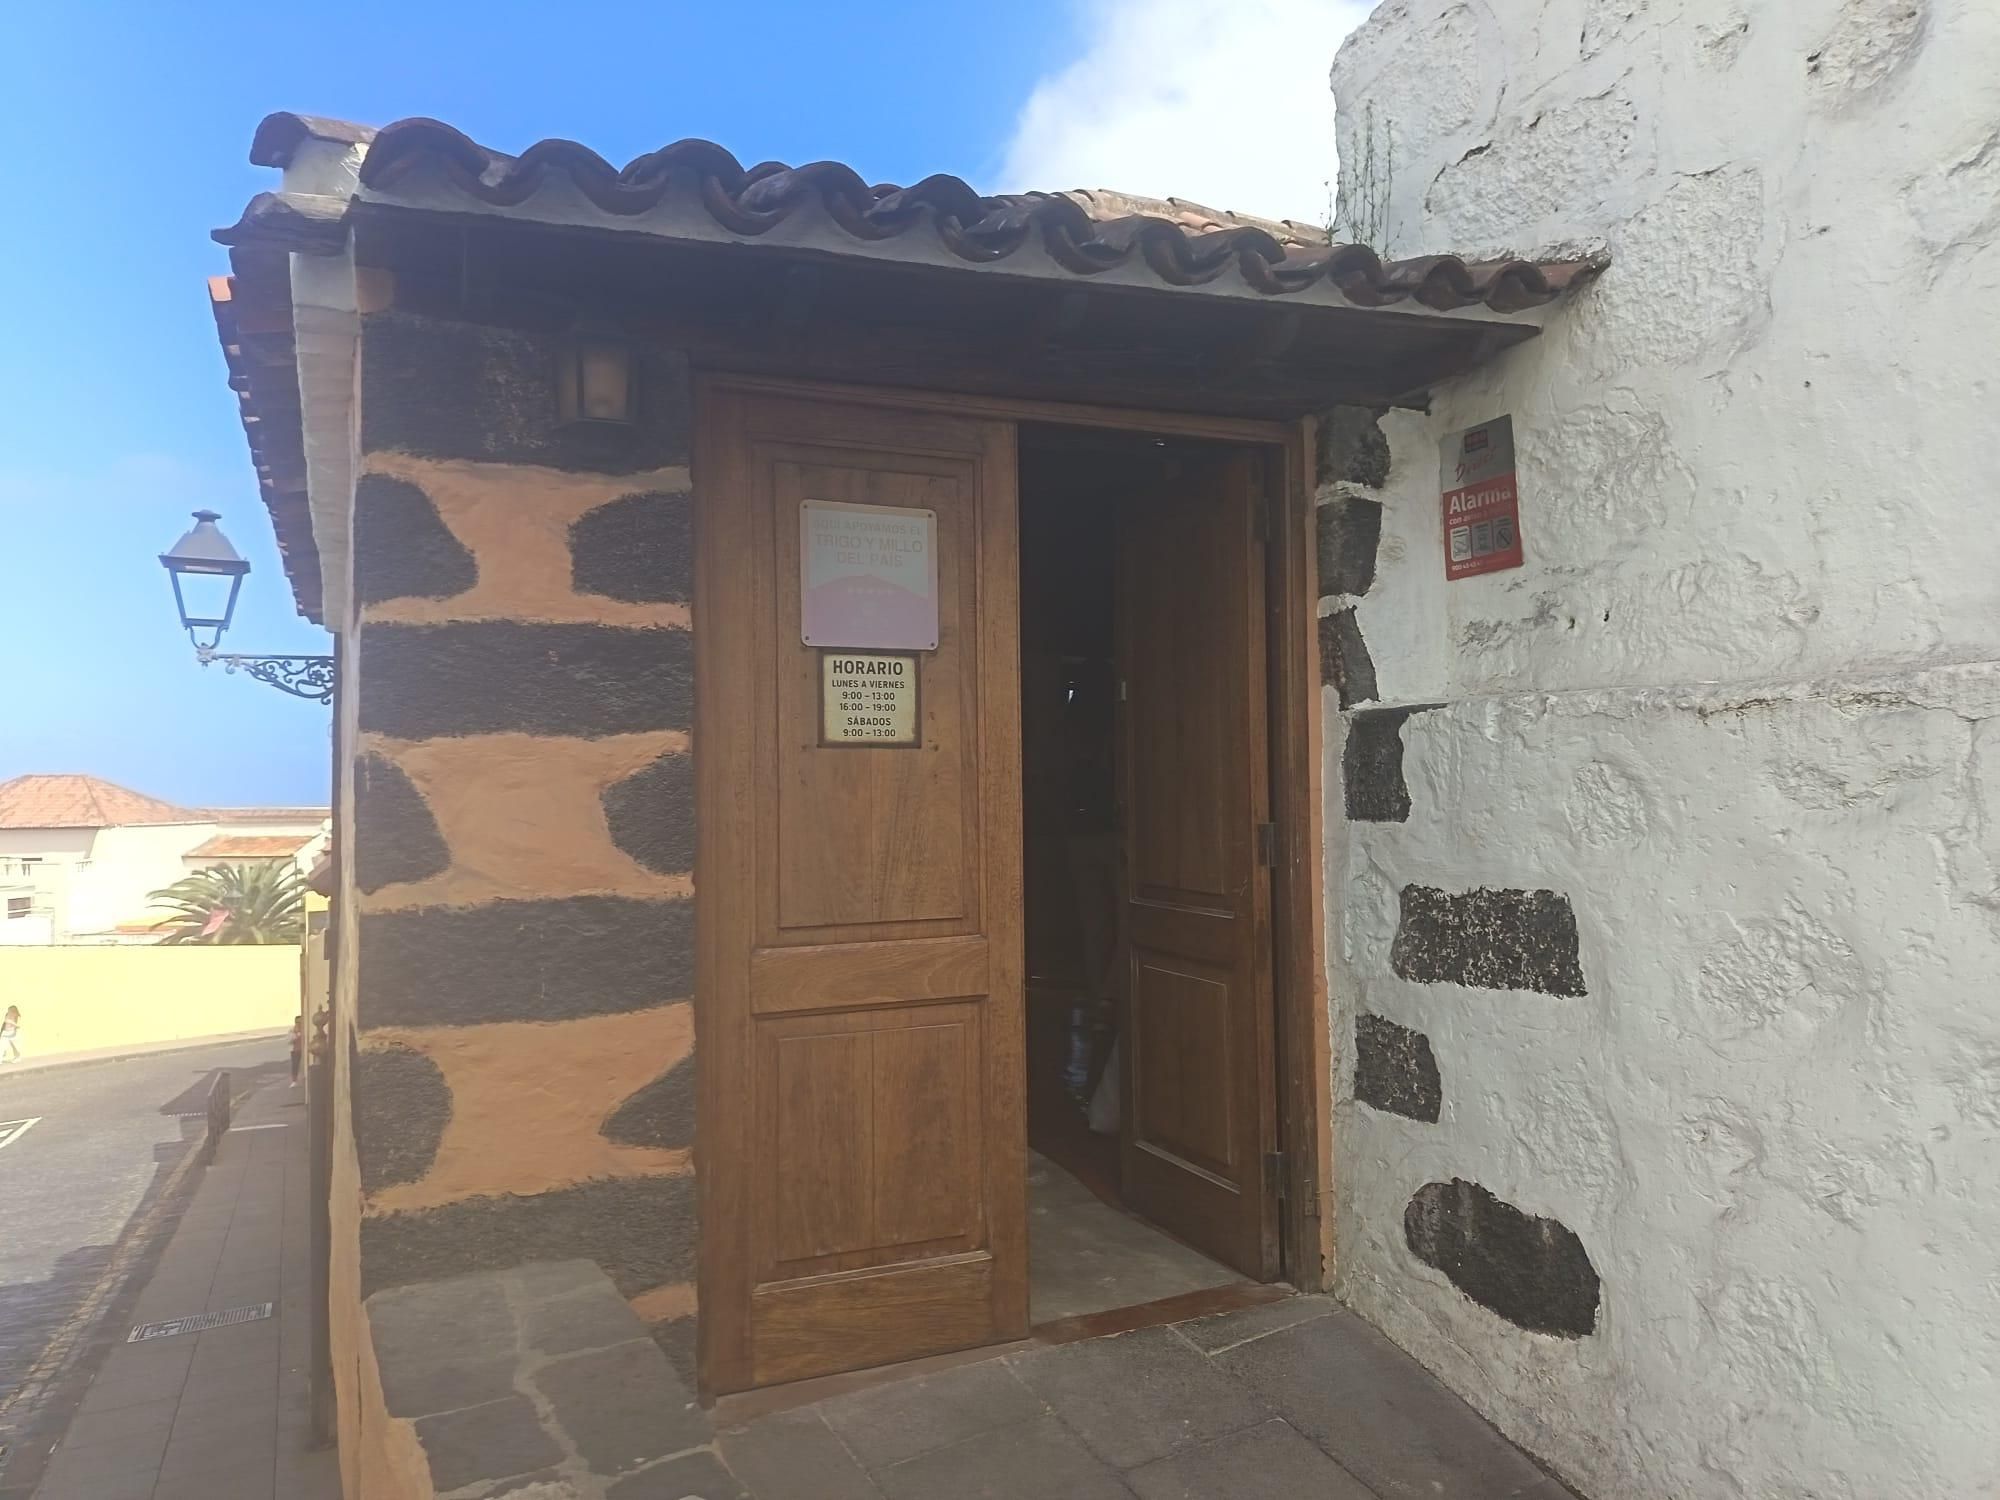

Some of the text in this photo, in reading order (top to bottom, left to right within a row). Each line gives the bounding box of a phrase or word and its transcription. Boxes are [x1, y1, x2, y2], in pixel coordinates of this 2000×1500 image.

[1449, 487, 1511, 515] Alarma
[815, 533, 923, 553] TRIGO Y MILLO
[837, 552, 865, 565] DEL
[833, 660, 904, 675] HORARIO
[832, 680, 859, 688] LUNES
[842, 691, 862, 700] 9:00
[872, 692, 895, 700] 13:00
[840, 703, 863, 711] 16:00
[873, 703, 896, 711] 19:00
[847, 716, 891, 726] SÁBADOS
[843, 729, 863, 737] 9:00
[873, 729, 896, 737] 13:00
